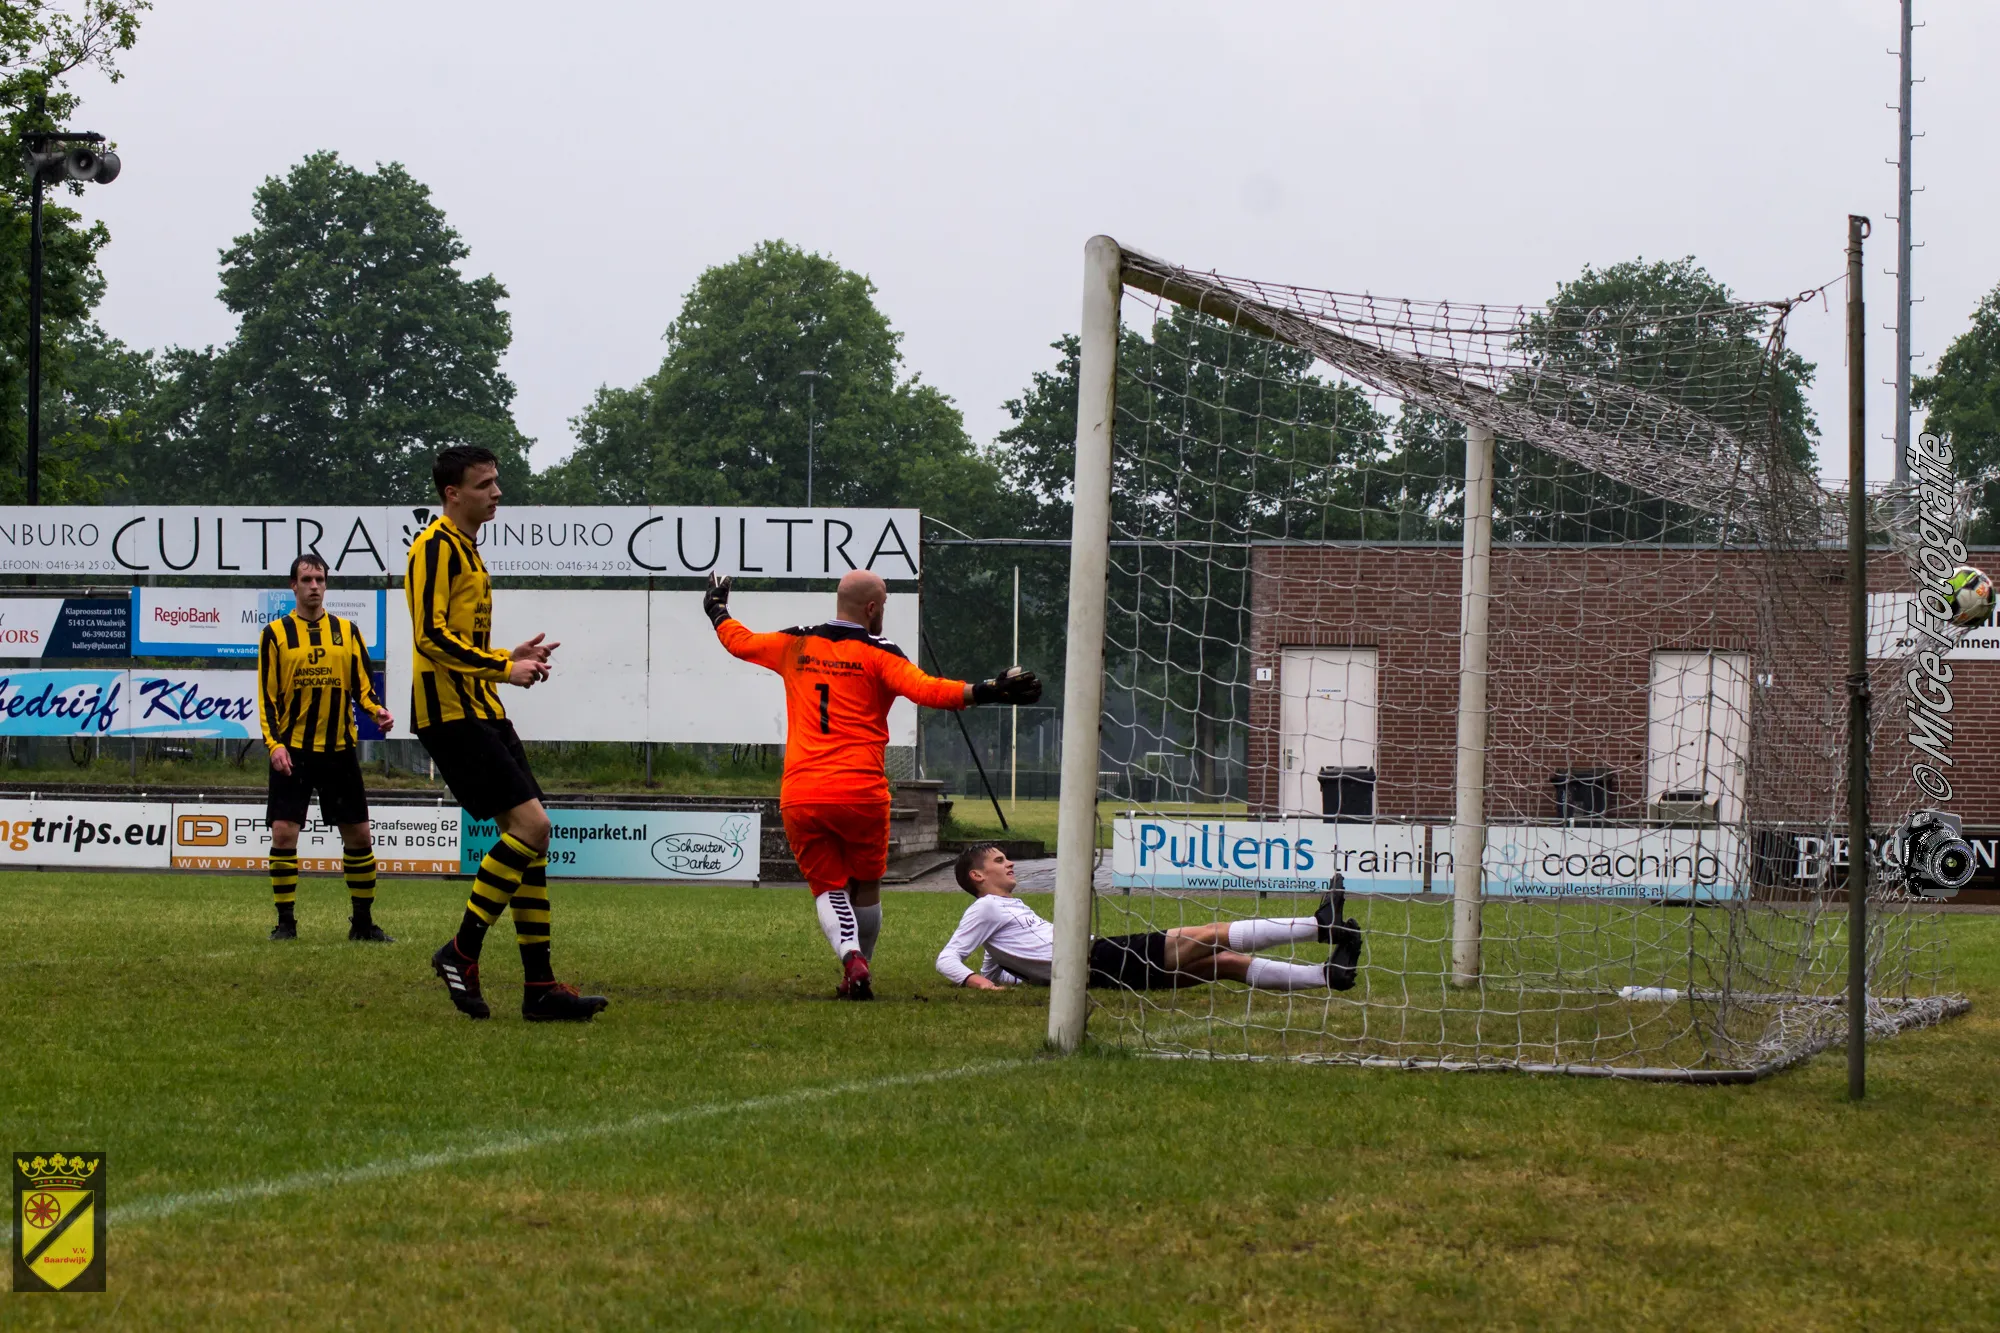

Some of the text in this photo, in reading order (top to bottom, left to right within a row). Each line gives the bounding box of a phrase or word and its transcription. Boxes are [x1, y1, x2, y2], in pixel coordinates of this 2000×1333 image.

[112, 516, 387, 571] CULTRA
[628, 516, 918, 575] CULTRA
[46, 560, 85, 570] 0416-34
[88, 560, 99, 570] 25
[102, 560, 116, 570] 02
[492, 561, 552, 571] TELEFOON:
[556, 561, 598, 571] 0416-34
[602, 561, 614, 571] 25
[617, 561, 631, 571] 02
[65, 608, 112, 616] Klaproosstraat
[155, 606, 220, 626] RegioBank
[68, 619, 126, 629] 5143 CA Waalwijk
[72, 642, 126, 651] halley@planet.nl
[294, 667, 332, 677] JANSSEN
[1262, 670, 1268, 679] 1
[293, 678, 341, 687] PACKAGING
[139, 679, 253, 721] Klerx
[815, 683, 830, 734] 1
[367, 818, 458, 834] Graafseweg 62
[405, 836, 458, 847] BOSCH
[665, 838, 726, 853] Schouten
[562, 852, 576, 863] 92
[668, 854, 721, 870] Parket
[1140, 824, 1314, 870] Pullens
[1542, 848, 1719, 885] coaching
[1187, 876, 1329, 893] www.pullenstraining.n
[1513, 883, 1665, 899] www.pullenstraining.nl
